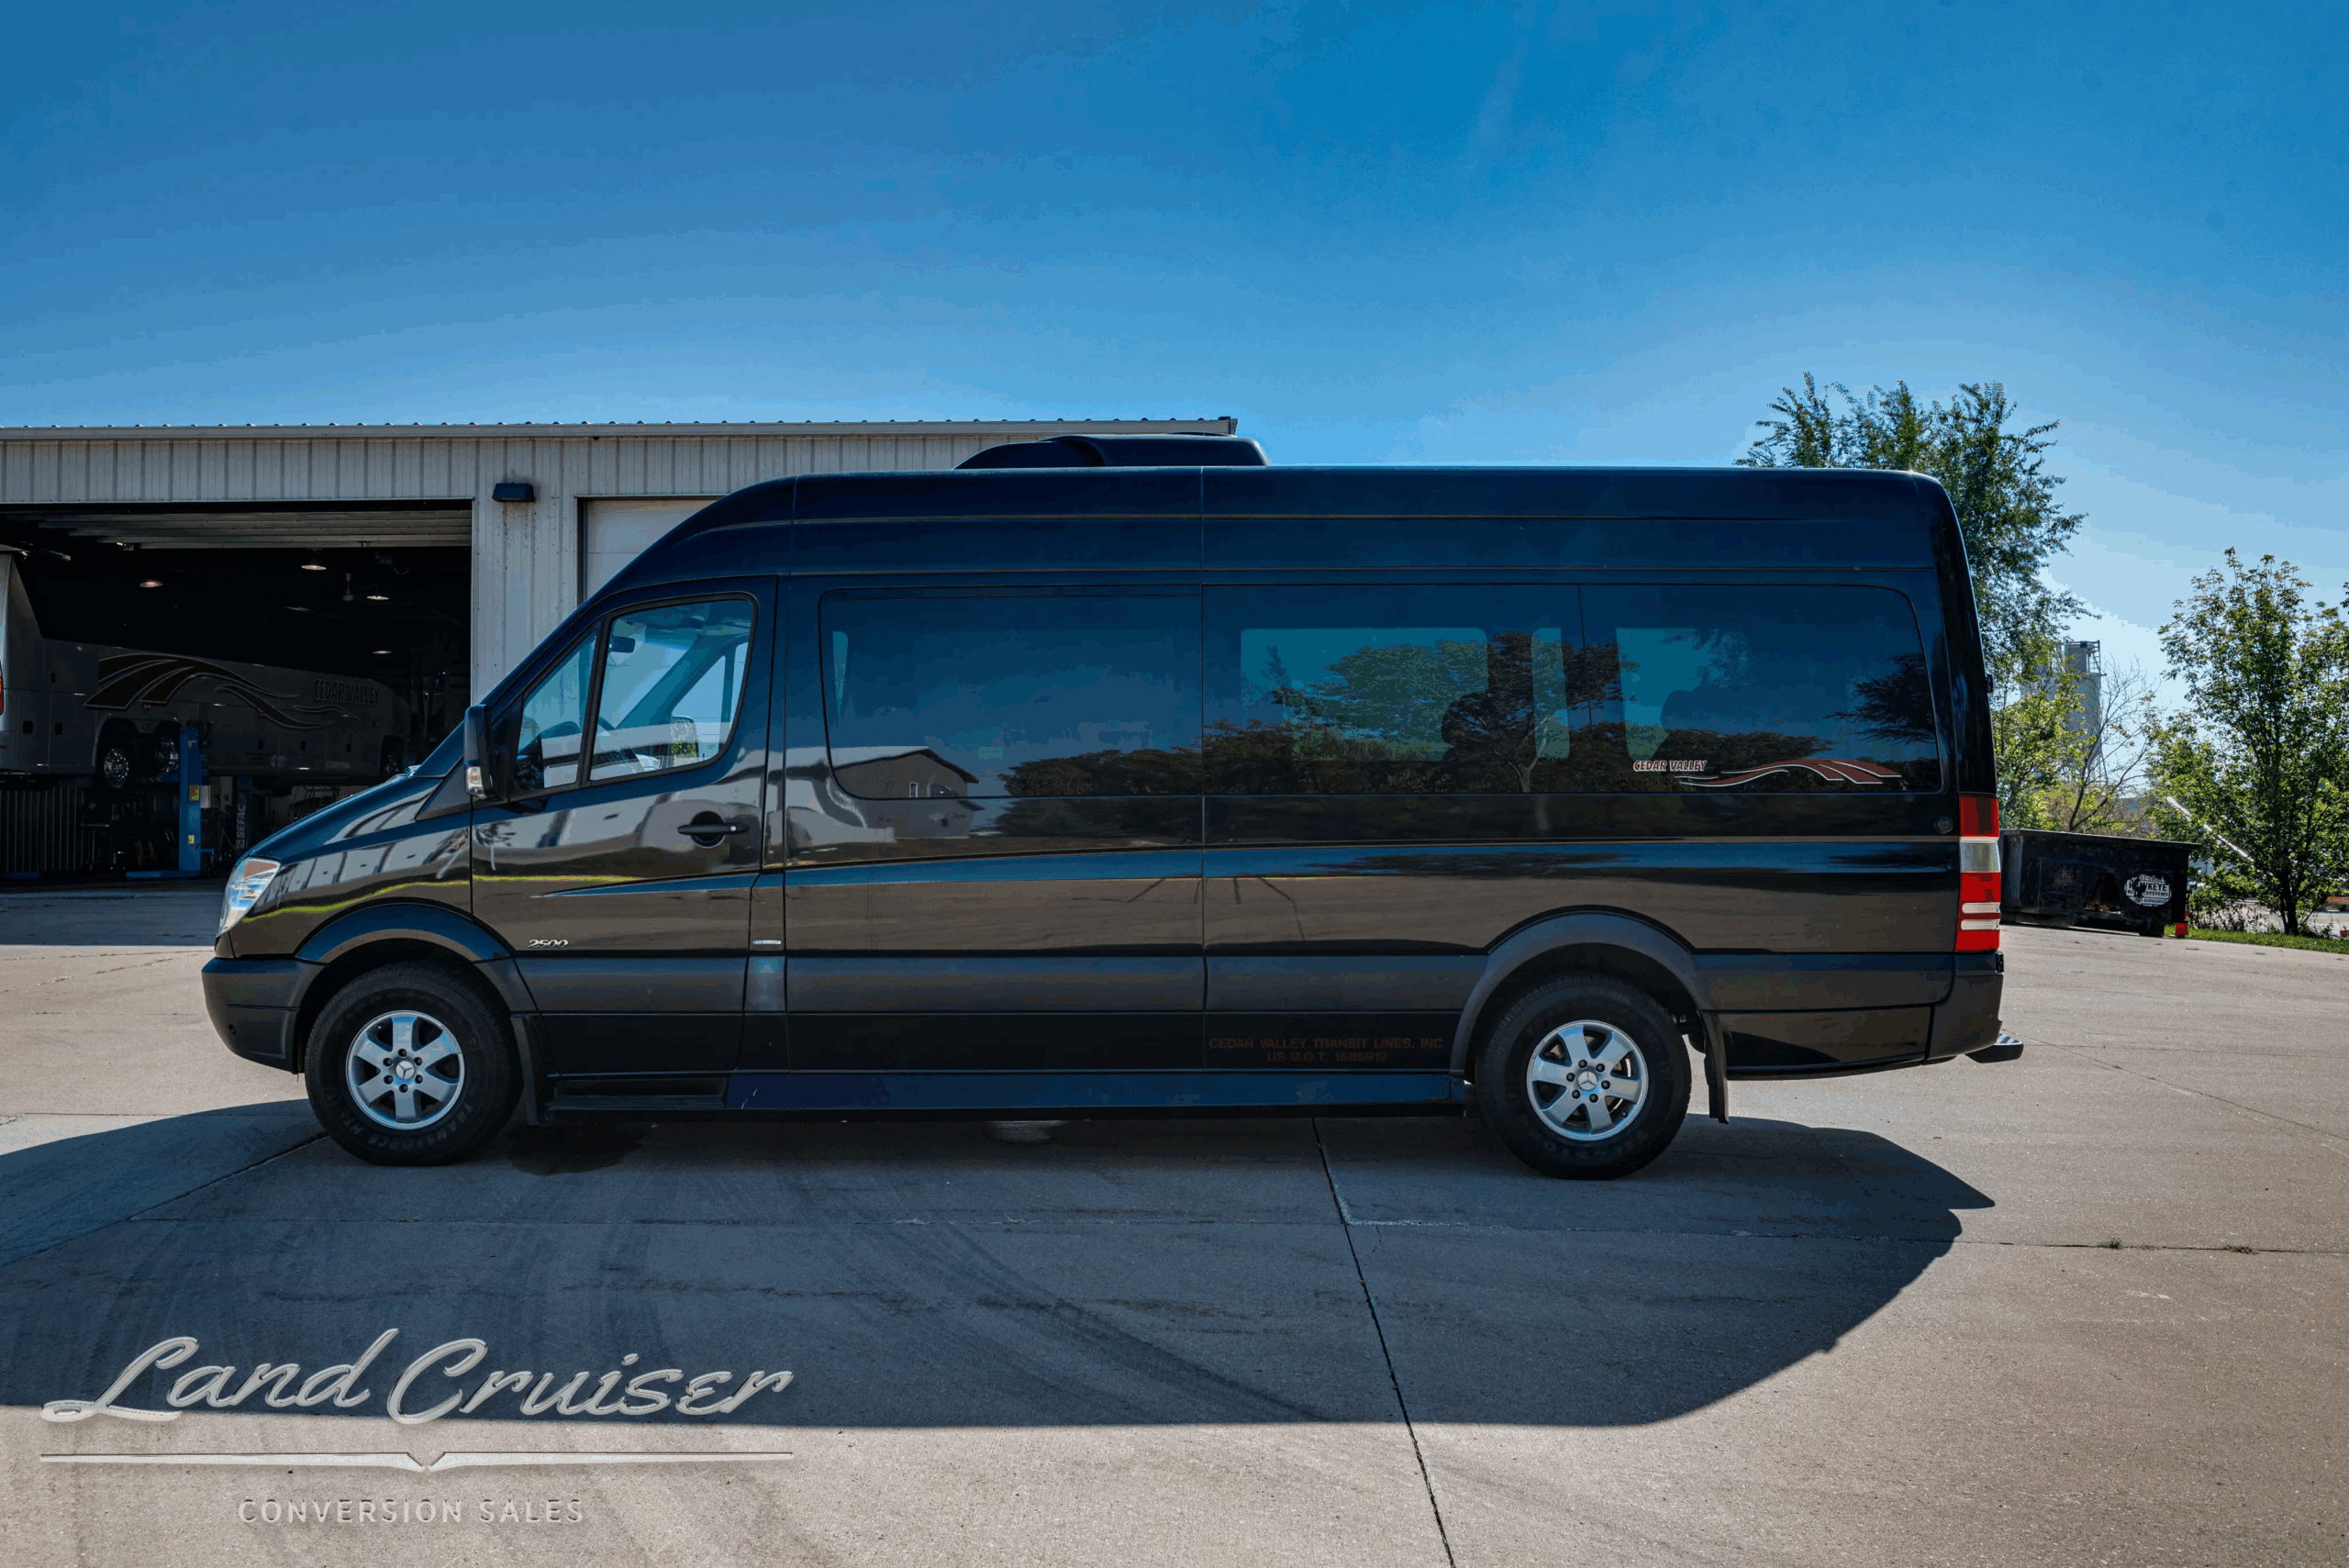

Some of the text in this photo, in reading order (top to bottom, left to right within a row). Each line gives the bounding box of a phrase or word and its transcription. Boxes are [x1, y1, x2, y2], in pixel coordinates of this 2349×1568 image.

[313, 679, 381, 706] CEDAR VALLEY
[1633, 760, 1708, 772] CEDAR VALLEY
[237, 803, 246, 838] SEFAC
[527, 939, 568, 948] 2500
[1208, 1038, 1253, 1049] CEDAR
[1260, 1038, 1307, 1049] VALLEY
[1313, 1038, 1368, 1049] TRANSIT
[1267, 1051, 1286, 1062] US
